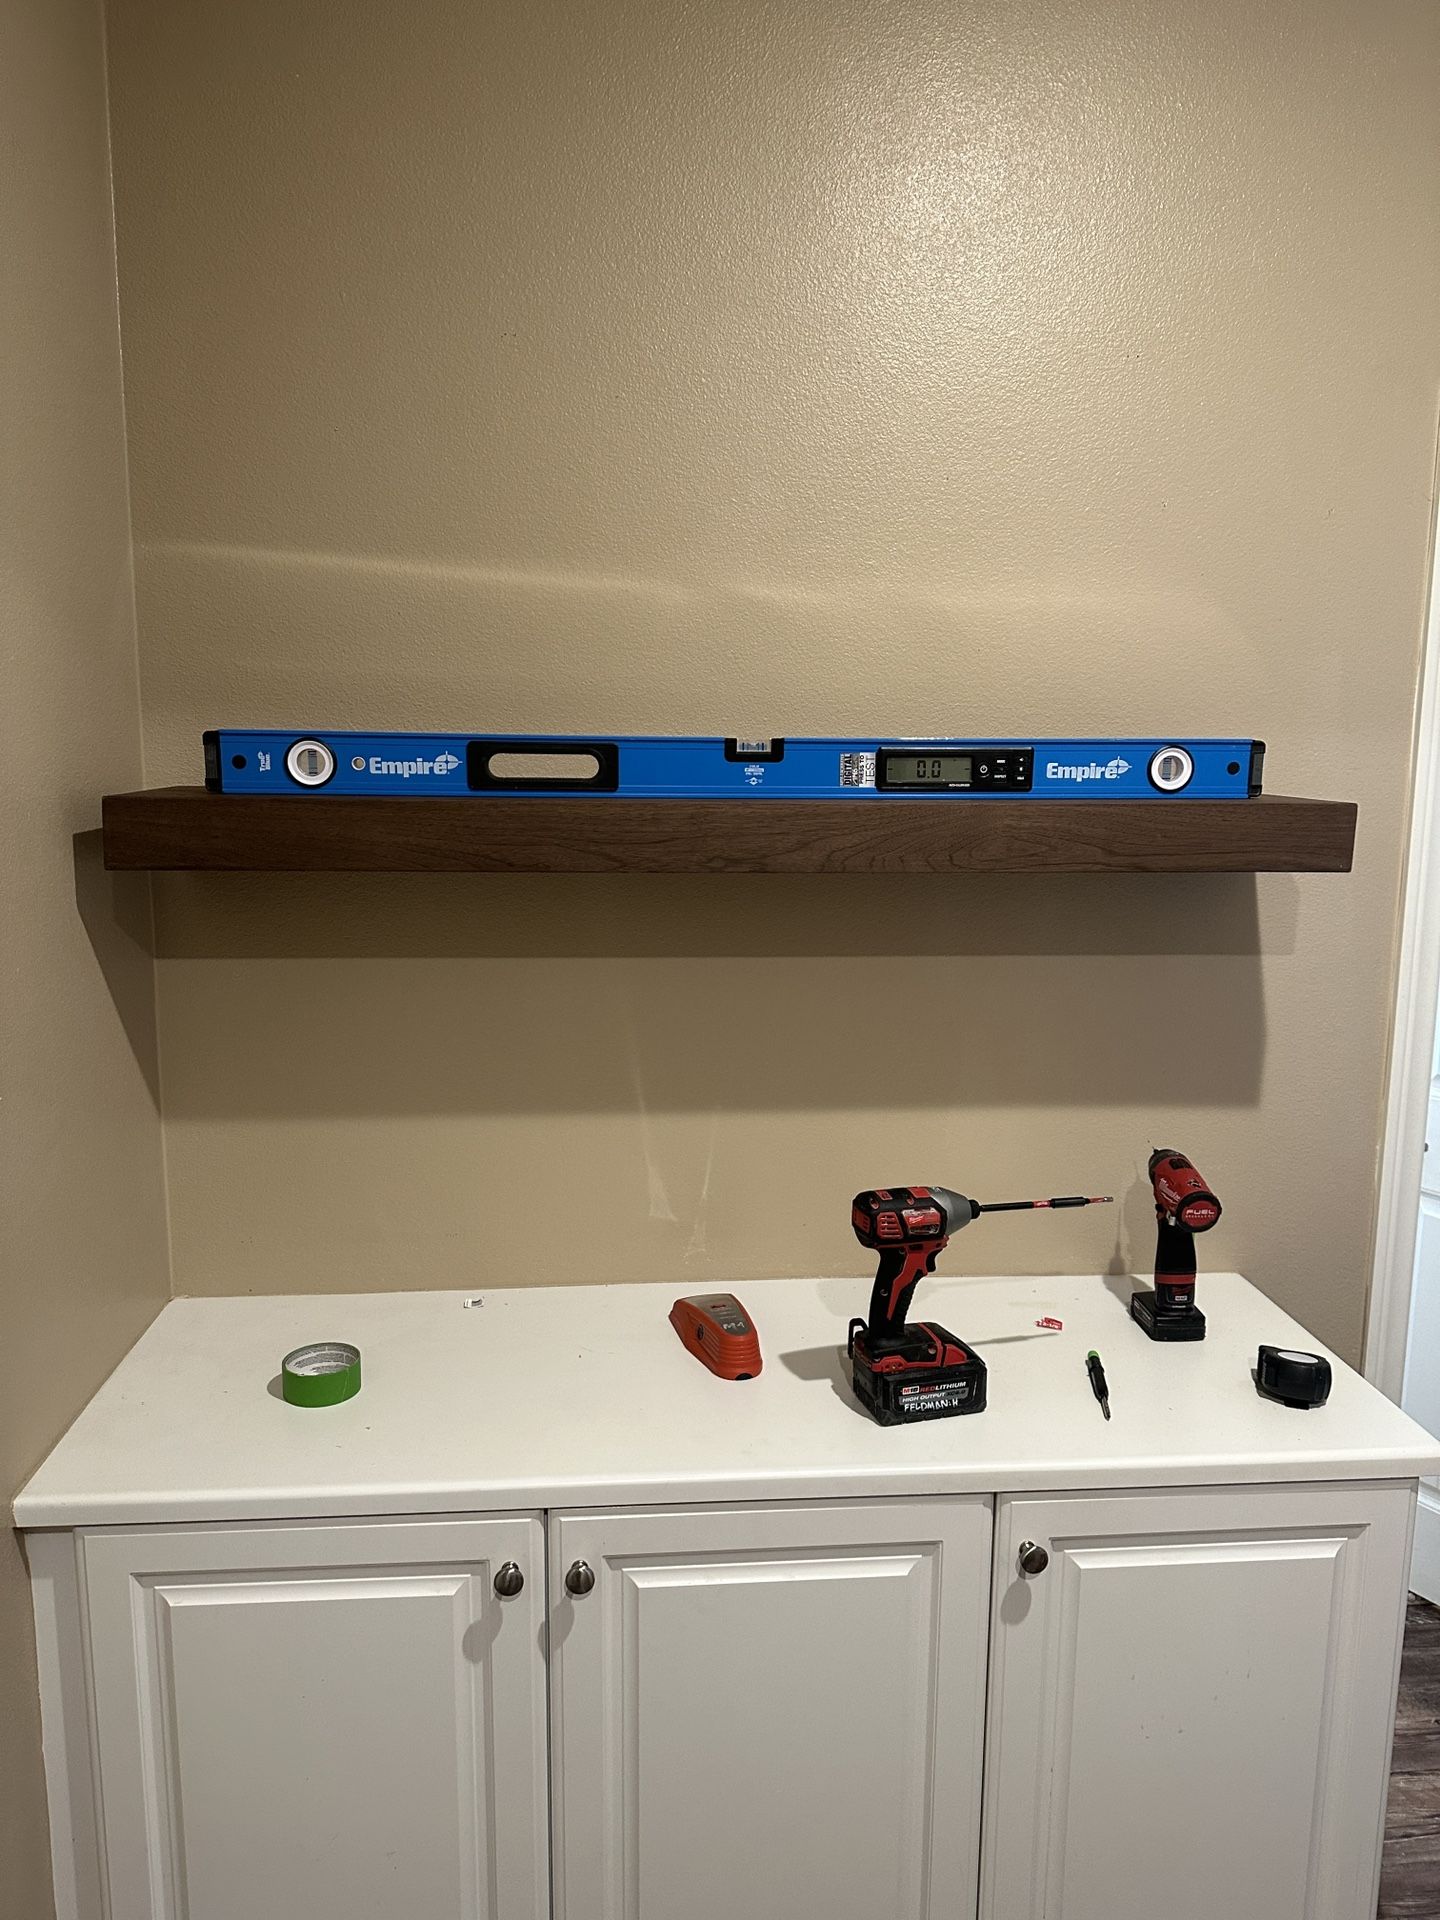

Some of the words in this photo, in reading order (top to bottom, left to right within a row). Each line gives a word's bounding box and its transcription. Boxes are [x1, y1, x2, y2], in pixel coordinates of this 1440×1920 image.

[369, 757, 448, 778] Empire
[859, 754, 865, 764] TO
[865, 754, 875, 783] TEST
[916, 759, 941, 779] 0.0
[844, 753, 852, 786] DIGITAL
[1046, 762, 1118, 782] Empire
[920, 1392, 946, 1400] OUTPUT
